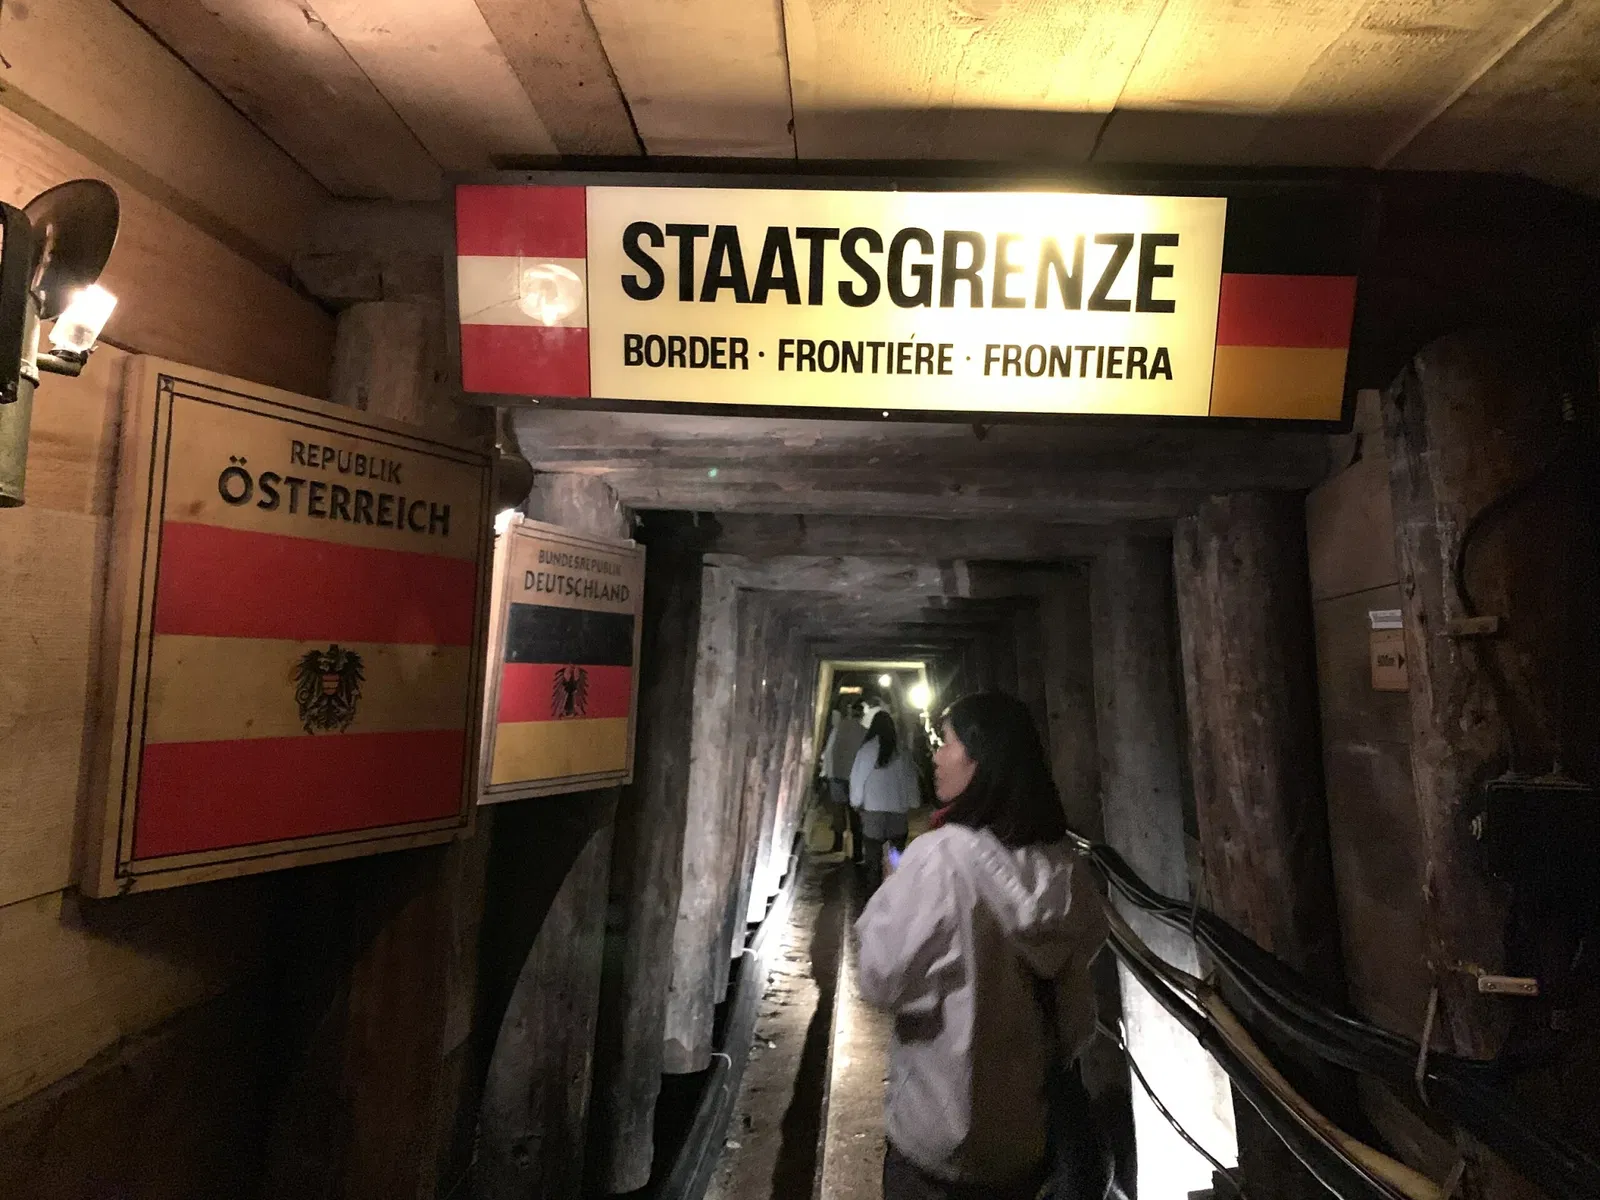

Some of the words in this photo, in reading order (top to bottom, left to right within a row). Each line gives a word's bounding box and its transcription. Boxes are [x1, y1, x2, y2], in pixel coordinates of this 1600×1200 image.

[621, 221, 1180, 314] STAATSGRENZE
[623, 333, 749, 370] BORDER
[983, 343, 1173, 380] FRONTIERA
[290, 439, 403, 485] REPUBLIK
[218, 455, 450, 536] ÖSTERREICH
[538, 549, 622, 577] BUNDESREPUBLIK
[524, 570, 631, 603] DEUTSCHLAND
